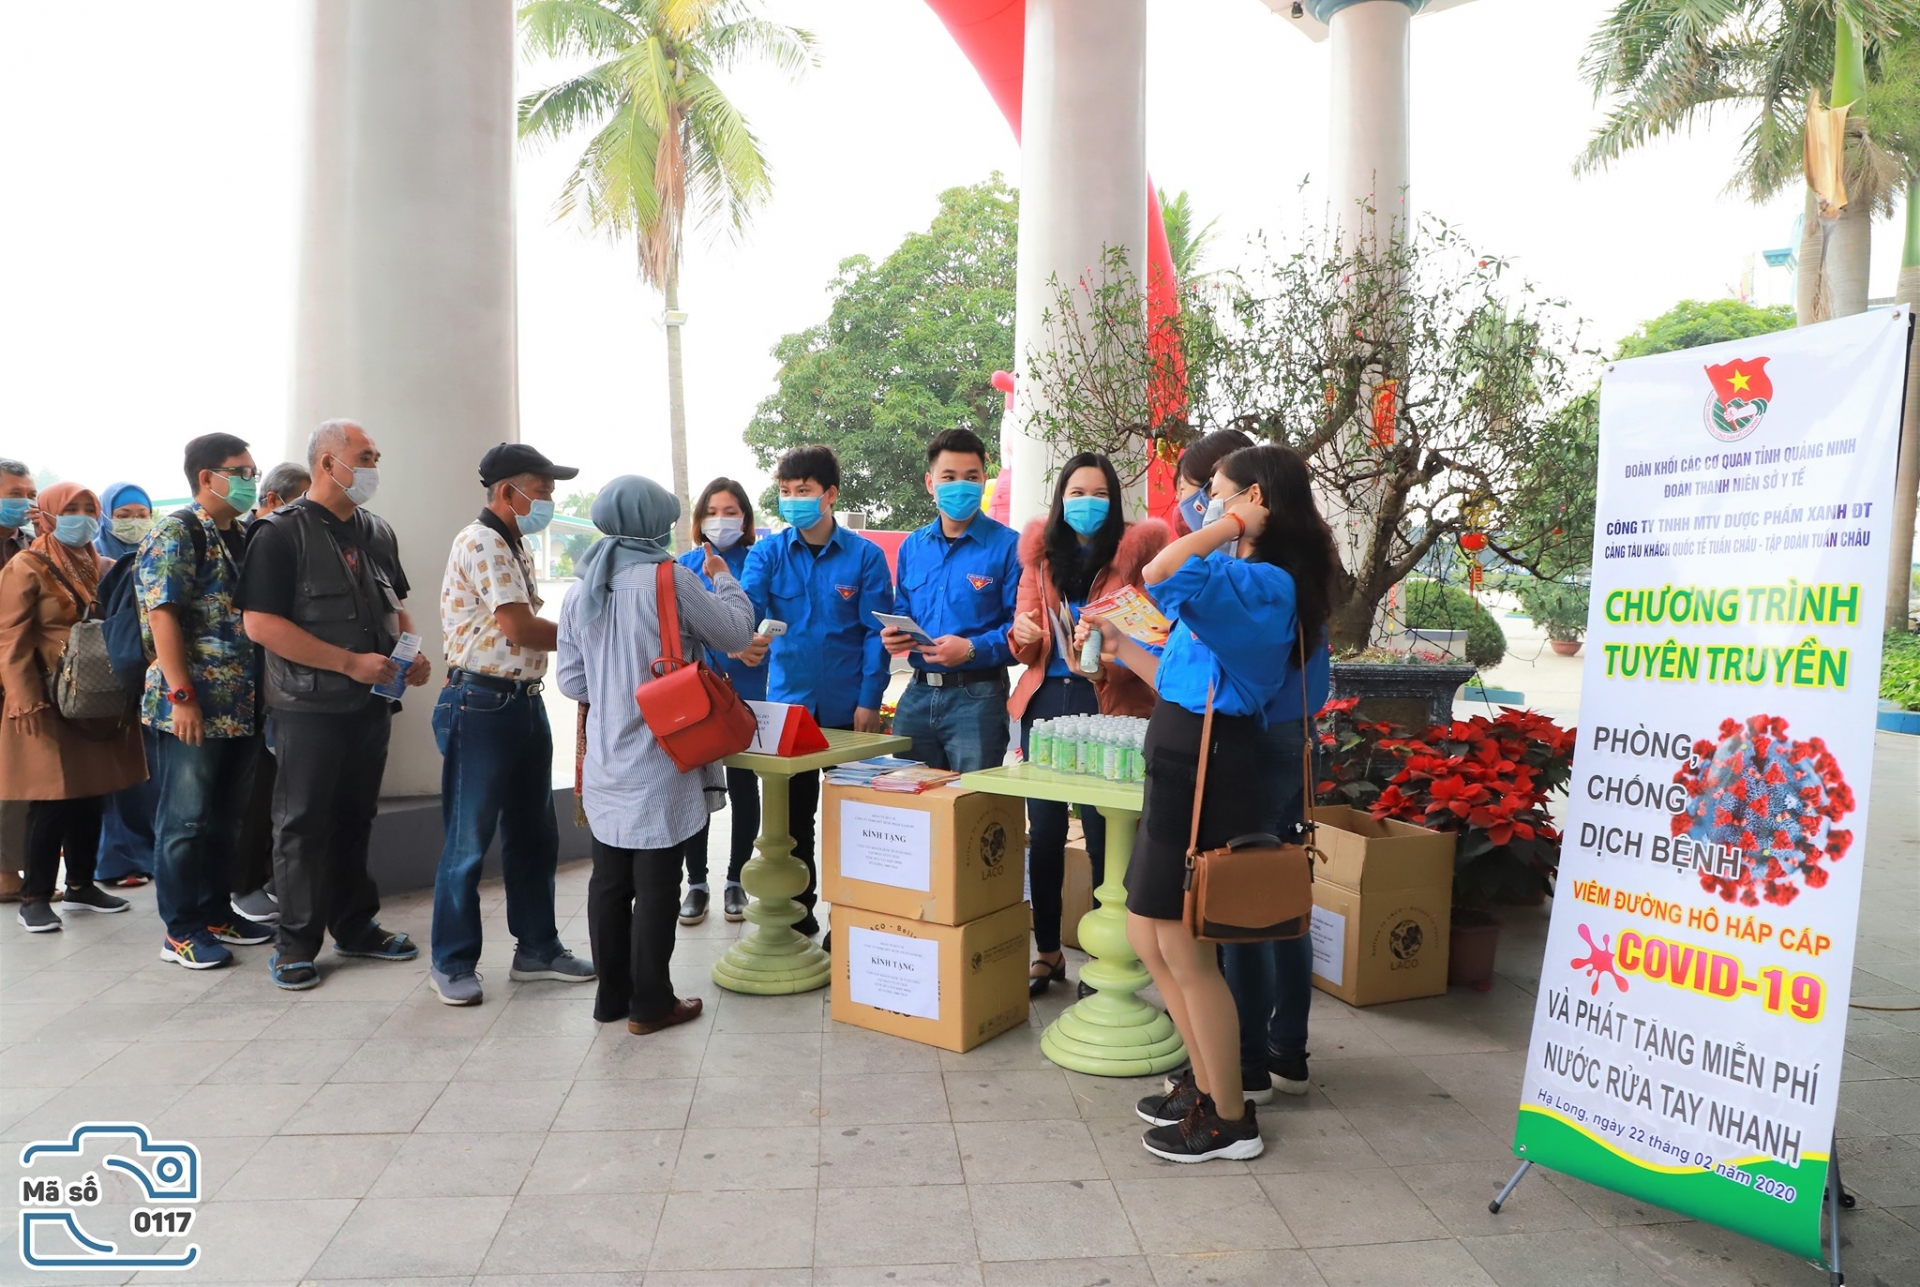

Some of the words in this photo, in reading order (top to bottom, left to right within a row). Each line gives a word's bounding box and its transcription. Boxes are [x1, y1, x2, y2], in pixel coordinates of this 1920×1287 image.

[1625, 461, 1651, 478] ĐOÀN
[1654, 455, 1678, 475] KHỐI
[1680, 455, 1701, 472] CÁC
[1704, 454, 1719, 470] CƠ
[1722, 452, 1751, 470] QUAN
[1755, 445, 1780, 464] TỈNH
[1784, 440, 1824, 463] QUẢNG
[1826, 438, 1856, 456] NINH
[1664, 480, 1692, 498] ĐOÀN
[1695, 479, 1730, 495] THANH
[1732, 474, 1760, 492] NIÊN
[1762, 469, 1779, 490] SỞ
[1782, 472, 1788, 488] Y
[1792, 466, 1806, 486] TẾ
[1606, 519, 1638, 535] CÔNG
[1642, 520, 1654, 533] TY
[1658, 517, 1690, 532] TNHH
[1694, 515, 1720, 530] MTV
[1724, 511, 1760, 530] DƯỢC
[1763, 503, 1803, 525] PHẨM
[1806, 504, 1847, 521] XANH
[1852, 502, 1873, 519] ĐT
[1604, 541, 1626, 559] CẢNG
[1627, 542, 1642, 558] TÀU
[1644, 540, 1670, 557] KHÁCH
[1672, 537, 1694, 557] QUỐC
[1697, 536, 1708, 554] TẾ
[1709, 535, 1731, 554] TUẤN
[1733, 535, 1757, 553] CHÂU
[1765, 533, 1782, 554] TẬP
[1783, 532, 1809, 550] ĐOÀN
[1812, 527, 1838, 548] TUẤN
[1840, 528, 1870, 547] CHÂU
[1605, 583, 1739, 624] CHƯƠNG
[1746, 577, 1861, 624] TRÌNH
[1603, 638, 1700, 681] TUYÊN
[1705, 636, 1848, 688] TRUYỀN
[1593, 723, 1698, 768] PHÒNG,
[1587, 774, 1687, 814] CHỐNG
[982, 865, 1004, 880] LACO
[1579, 822, 1643, 858] DỊCH
[1650, 834, 1742, 878] BỆNH
[1572, 880, 1610, 907] VIÊM
[1614, 889, 1682, 926] ĐƯỜNG
[1688, 907, 1720, 934] HÔ
[1725, 913, 1773, 945] HẤP
[1780, 927, 1831, 957] CẤP
[1390, 959, 1419, 971] LACO
[1617, 931, 1823, 1020] COVID-19
[1548, 986, 1570, 1024] VÀ
[1575, 1001, 1628, 1043] PHÁT
[1633, 1018, 1696, 1066] TẶNG
[1702, 1040, 1765, 1089] MIỄN
[1772, 1061, 1820, 1106] PHÍ
[1544, 1041, 1601, 1089] NƯỚC
[1606, 1064, 1653, 1111] RỬA
[1660, 1084, 1704, 1126] TAY
[1708, 1100, 1801, 1164] NHANH
[1537, 1088, 1554, 1108] Hạ
[1556, 1095, 1589, 1122] Long,
[1593, 1113, 1626, 1140] ngày
[1629, 1126, 1646, 1144] 22
[1648, 1134, 1690, 1164] tháng
[1694, 1152, 1712, 1171] 02
[1716, 1162, 1751, 1186] năm
[1755, 1176, 1796, 1202] 2020
